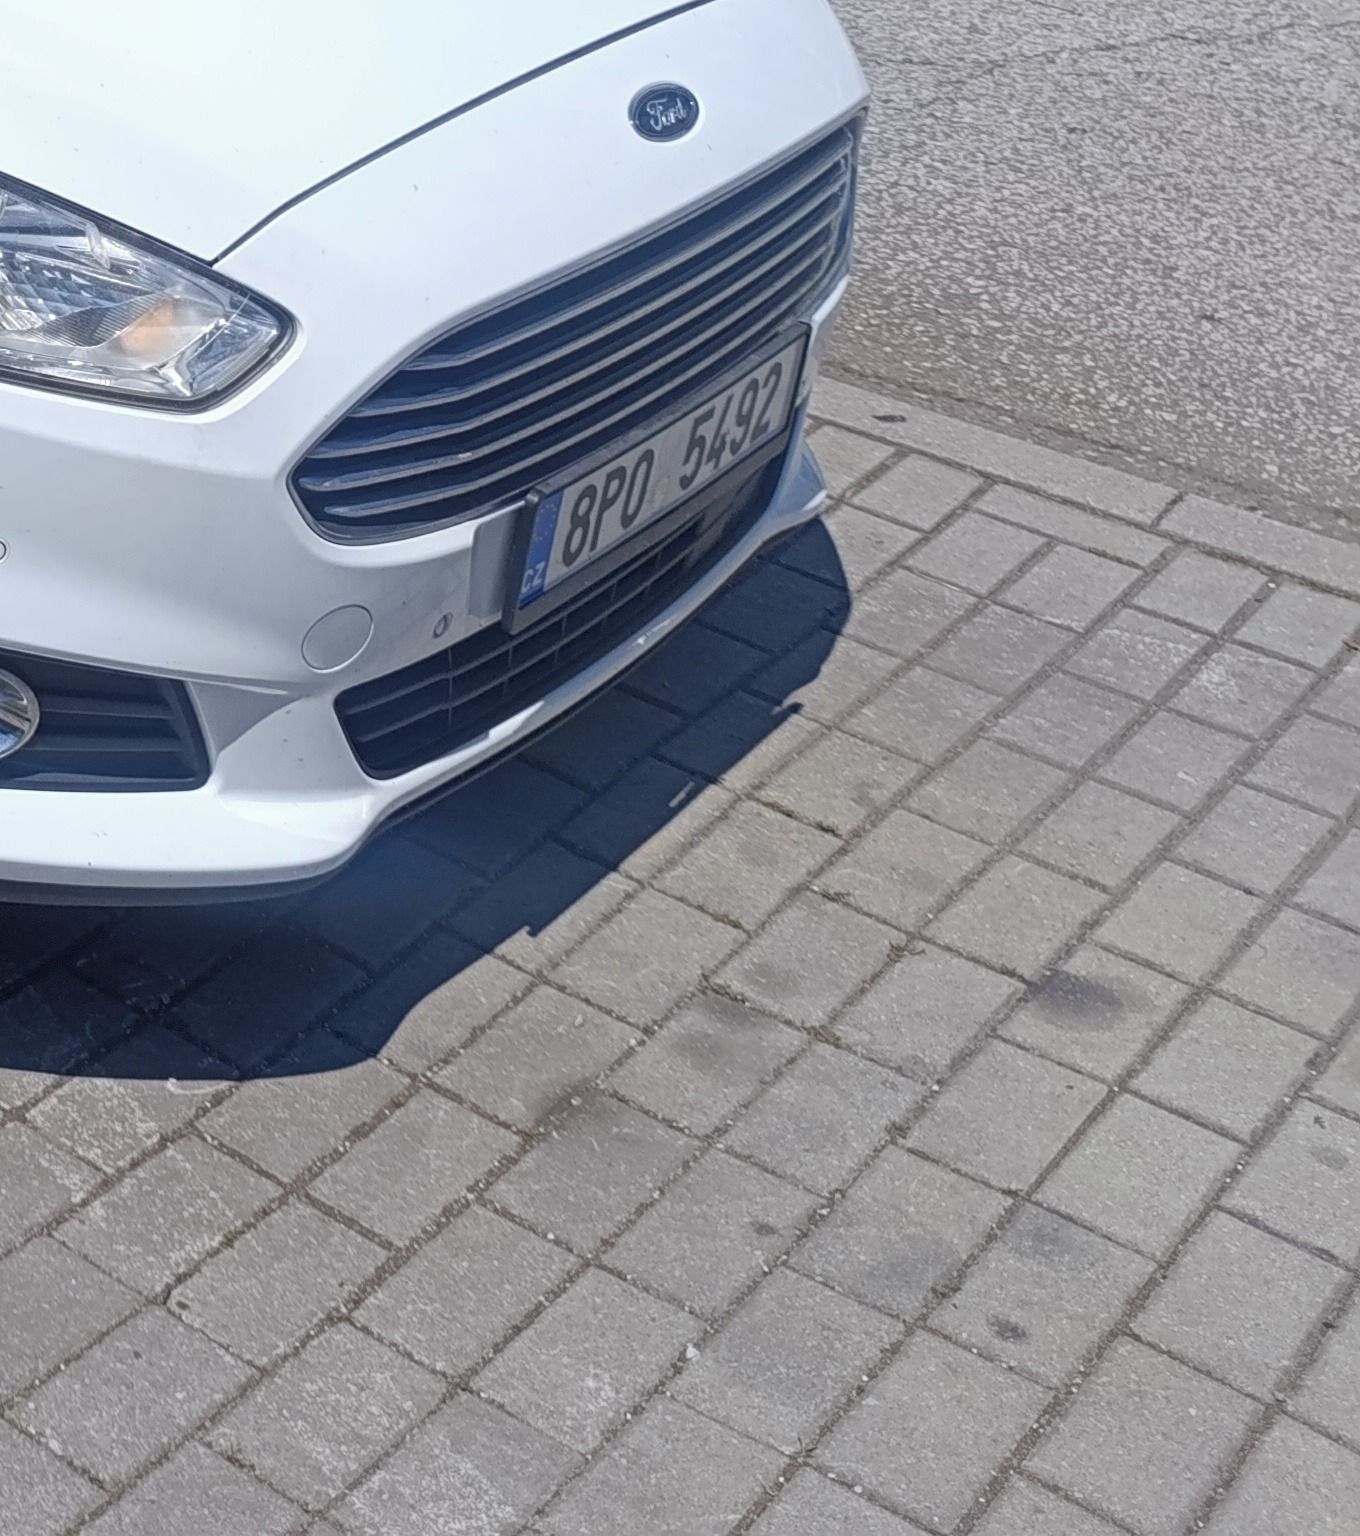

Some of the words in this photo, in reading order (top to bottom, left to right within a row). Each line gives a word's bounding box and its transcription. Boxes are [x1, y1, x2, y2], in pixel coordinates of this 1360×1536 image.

[646, 96, 688, 131] Ford
[561, 448, 655, 568] 8P0
[678, 361, 783, 491] 5492
[520, 560, 548, 594] CZ
